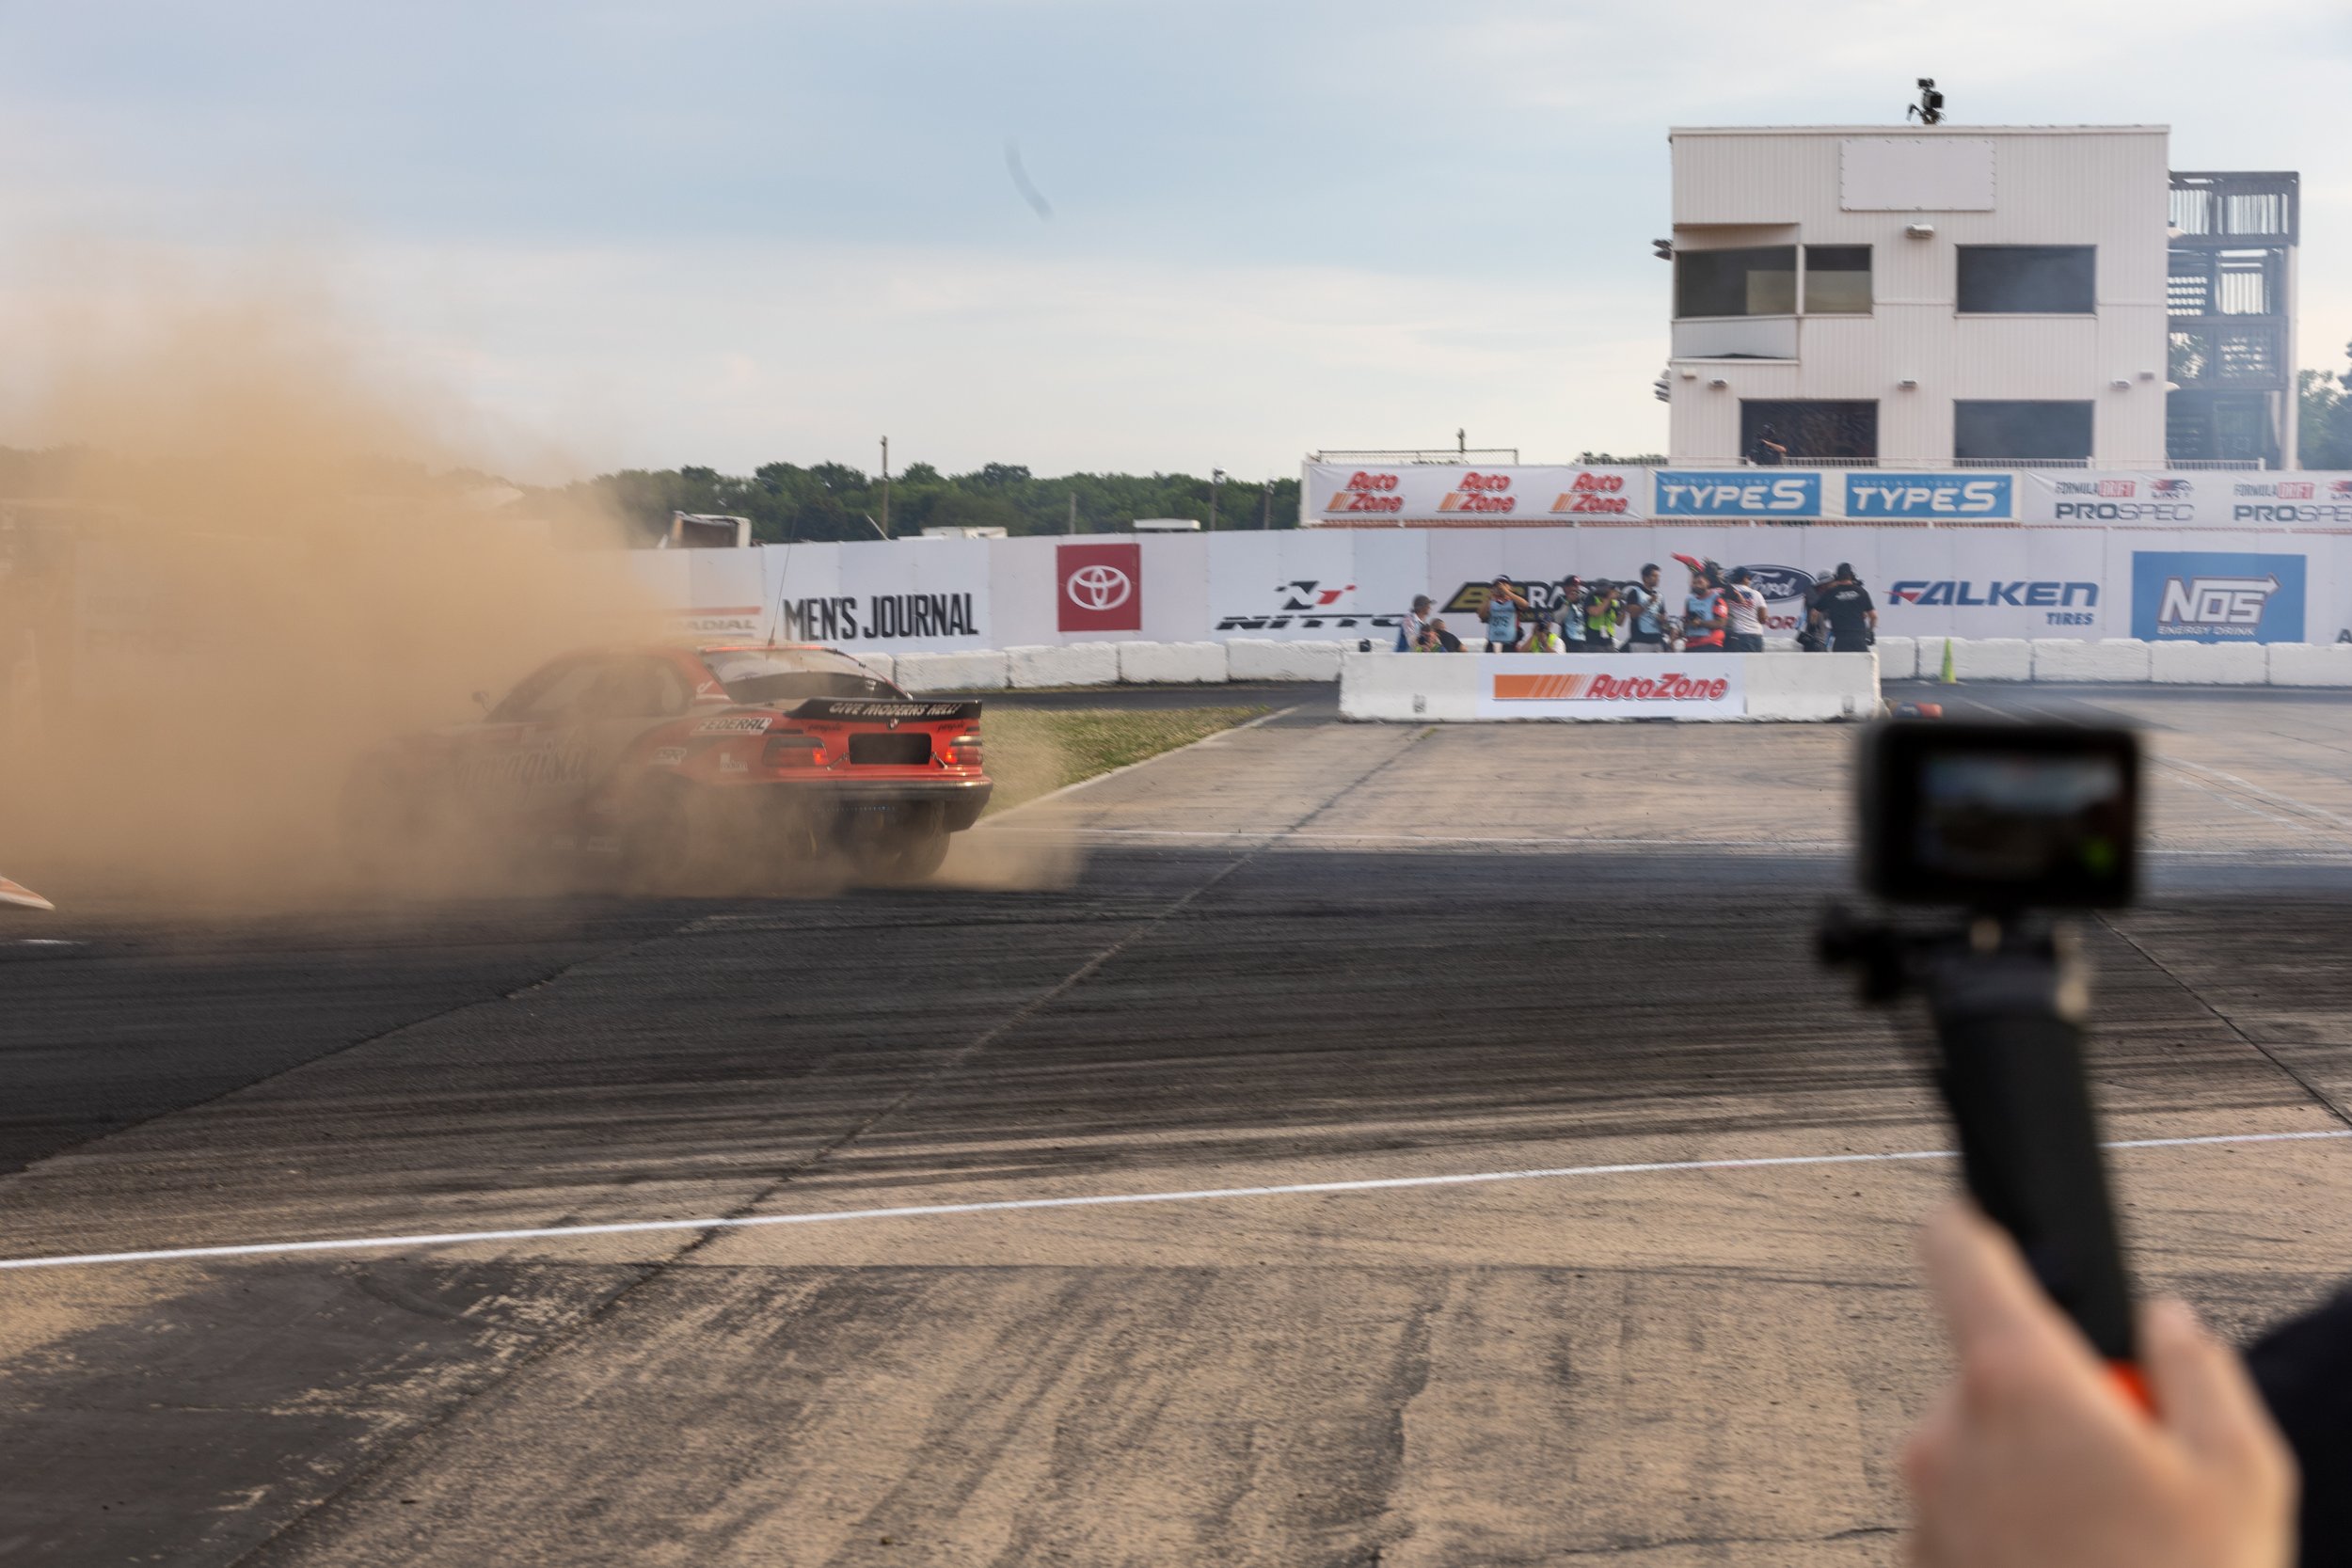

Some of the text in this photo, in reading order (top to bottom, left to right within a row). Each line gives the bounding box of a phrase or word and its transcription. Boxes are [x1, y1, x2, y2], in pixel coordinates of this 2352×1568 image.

[1347, 471, 1398, 489] Auto
[1459, 472, 1511, 491] Auto
[1572, 472, 1624, 492] Auto
[1347, 493, 1404, 513] Zone
[1459, 494, 1517, 513] Zone
[1572, 494, 1629, 513] Zone
[2233, 505, 2352, 522] PROSPE
[1886, 580, 2099, 607] FALKEN
[2158, 577, 2280, 626] NOS
[783, 593, 979, 641] MEN'S JOURNAL
[2045, 612, 2095, 626] TIRES
[2157, 626, 2256, 636] ENERGY DRINK
[1585, 673, 1727, 701] AutoZone
[829, 703, 865, 715] GIVE
[863, 704, 927, 717] MODERNS
[697, 718, 766, 731] FEDERAL
